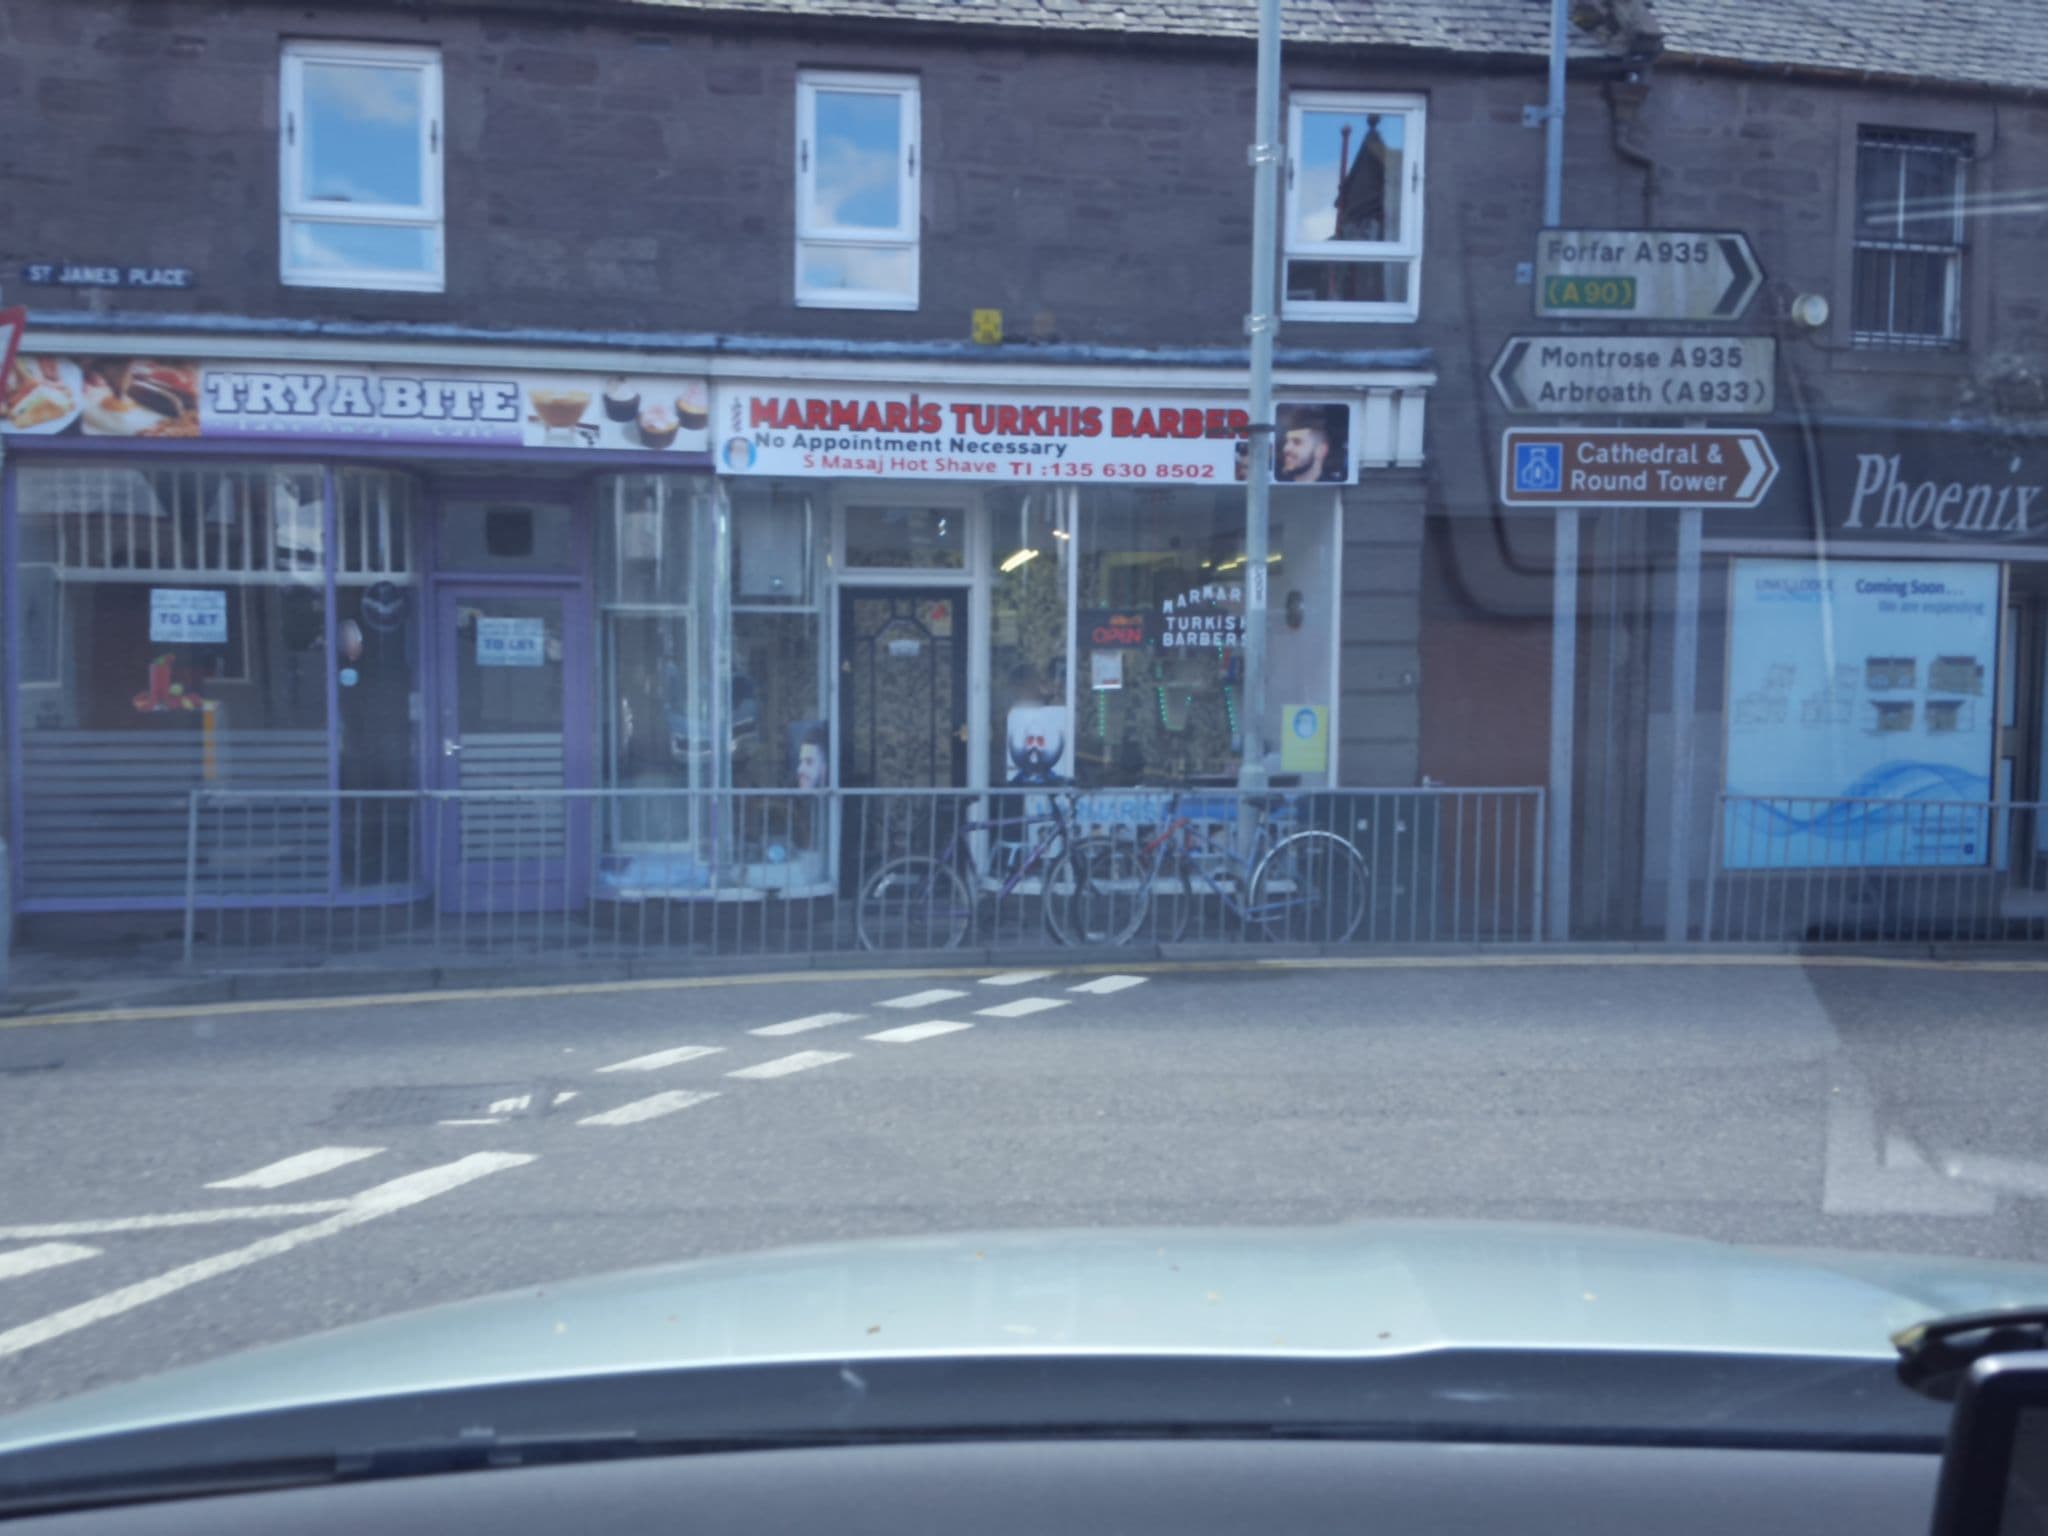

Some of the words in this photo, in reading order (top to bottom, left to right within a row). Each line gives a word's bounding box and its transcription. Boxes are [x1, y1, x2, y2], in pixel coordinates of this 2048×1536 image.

[1547, 240, 1624, 263] Forfar
[58, 265, 119, 285] JAMES
[128, 267, 186, 287] PLACE
[1541, 346, 1660, 368] Montrose
[205, 371, 326, 416] TRY
[329, 375, 376, 418] A
[379, 378, 519, 423] BITE
[1539, 381, 1651, 402] Arbroath
[951, 403, 1104, 437] TURKHIS
[755, 432, 785, 449] No
[792, 433, 942, 453] Appointment
[950, 436, 1067, 458] Necessary
[1576, 441, 1698, 465] Cathedral
[1706, 443, 1724, 465] &
[803, 454, 815, 468] S
[821, 455, 884, 474] Masaj
[890, 457, 929, 472] Hot
[935, 457, 997, 473] Shave
[1103, 463, 1147, 478] 630
[1156, 463, 1215, 479] 8502
[1570, 469, 1648, 492] Round
[1656, 469, 1728, 492] Tower
[1843, 452, 2043, 533] Phoenix
[1855, 577, 1906, 598] Coming
[159, 612, 182, 625] TO
[1092, 627, 1143, 645] OPEN
